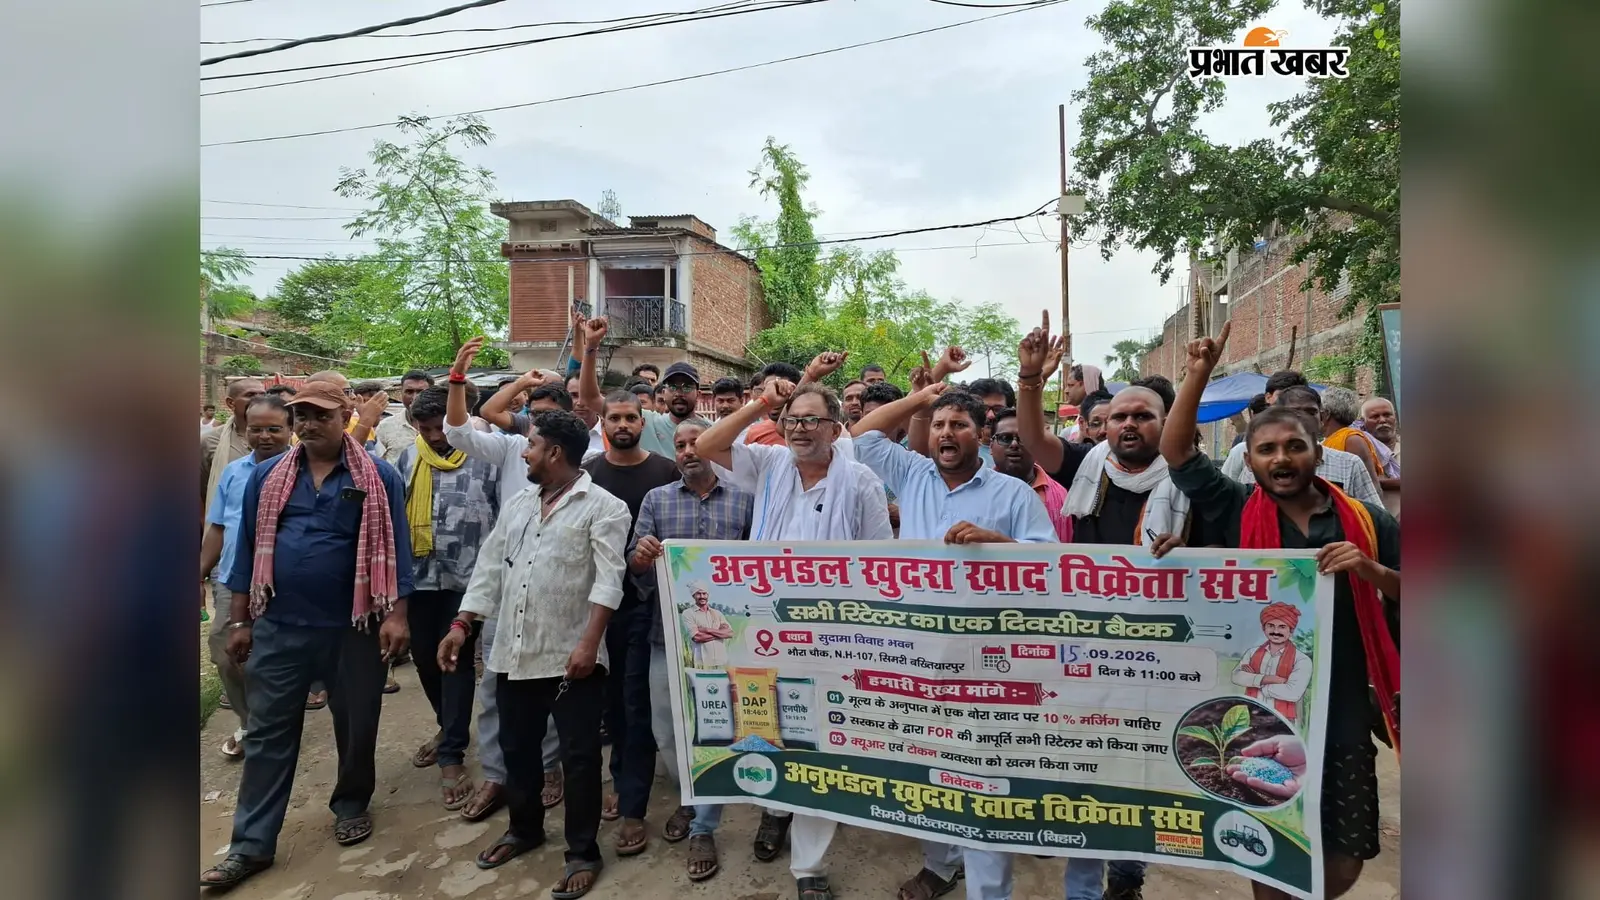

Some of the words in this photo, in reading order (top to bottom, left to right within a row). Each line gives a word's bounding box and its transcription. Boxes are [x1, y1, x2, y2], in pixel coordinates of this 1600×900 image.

[710, 548, 851, 594] अनुमंडल
[858, 557, 955, 599] खुदरा
[963, 561, 1049, 593] खाद
[1059, 554, 1189, 600] विक्रेता
[1199, 560, 1274, 601] संघ
[786, 600, 835, 621] सभी
[838, 601, 908, 626] रिटेलर
[908, 612, 945, 630] का
[948, 615, 995, 632] एक
[998, 609, 1101, 635] दिवसीय
[1104, 614, 1176, 638] बैठक
[785, 633, 808, 642] स्थान
[818, 634, 851, 646] सुदामा
[854, 633, 885, 648] विवाह
[887, 638, 915, 650] भवन
[1017, 645, 1051, 658] दिनांक
[835, 651, 877, 663] N.H-107,
[879, 652, 907, 665] सिमरी
[1068, 664, 1088, 676] दिन
[1098, 665, 1120, 677] दिन
[1123, 666, 1136, 679] के
[1140, 669, 1176, 681] 11:00
[1179, 671, 1202, 683] बजे
[868, 675, 914, 692] हमारी
[919, 682, 960, 699] मुख्य
[966, 682, 1007, 698] मांगे
[701, 700, 728, 709] UREA
[742, 696, 767, 707] DAP
[782, 704, 808, 714] एनपीके
[829, 693, 841, 702] 01
[848, 695, 871, 708] मूल्य
[874, 696, 885, 708] के
[889, 699, 928, 714] अनुपात
[931, 704, 942, 716] में
[944, 707, 964, 718] एक
[993, 710, 1020, 722] खाद
[1023, 712, 1039, 723] पर
[1043, 713, 1059, 724] 10
[1062, 714, 1076, 725] %
[1123, 716, 1162, 731] चाहिए
[830, 713, 842, 723] 02
[849, 715, 885, 730] सरकार
[888, 719, 899, 731] के
[902, 723, 924, 735] द्वारा
[927, 726, 954, 739] FOR
[957, 728, 972, 742] की
[976, 732, 1012, 748] आपूर्ति
[1015, 733, 1041, 746] सभी
[1045, 735, 1082, 748] रिटेलर
[1086, 737, 1103, 750] को
[1107, 737, 1138, 752] किया
[1142, 743, 1169, 755] जाए
[831, 734, 842, 743] 03
[850, 736, 885, 751] क्यूआर
[888, 741, 903, 753] एवं
[906, 744, 937, 758] टोकन
[985, 754, 1002, 767] को
[1005, 757, 1035, 769] खत्म
[1039, 756, 1069, 770] किया
[1073, 761, 1099, 773] जाए
[939, 772, 984, 791] निवेदक
[784, 761, 887, 797] अनुमंडल
[889, 779, 966, 813] खुदरा
[969, 793, 1037, 820] खाद
[1040, 794, 1144, 826] विक्रेता
[1148, 801, 1205, 832] संघ
[870, 805, 906, 823] सिमरी
[986, 829, 1035, 843] सहरसा
[1037, 829, 1087, 848] (बिहार)
